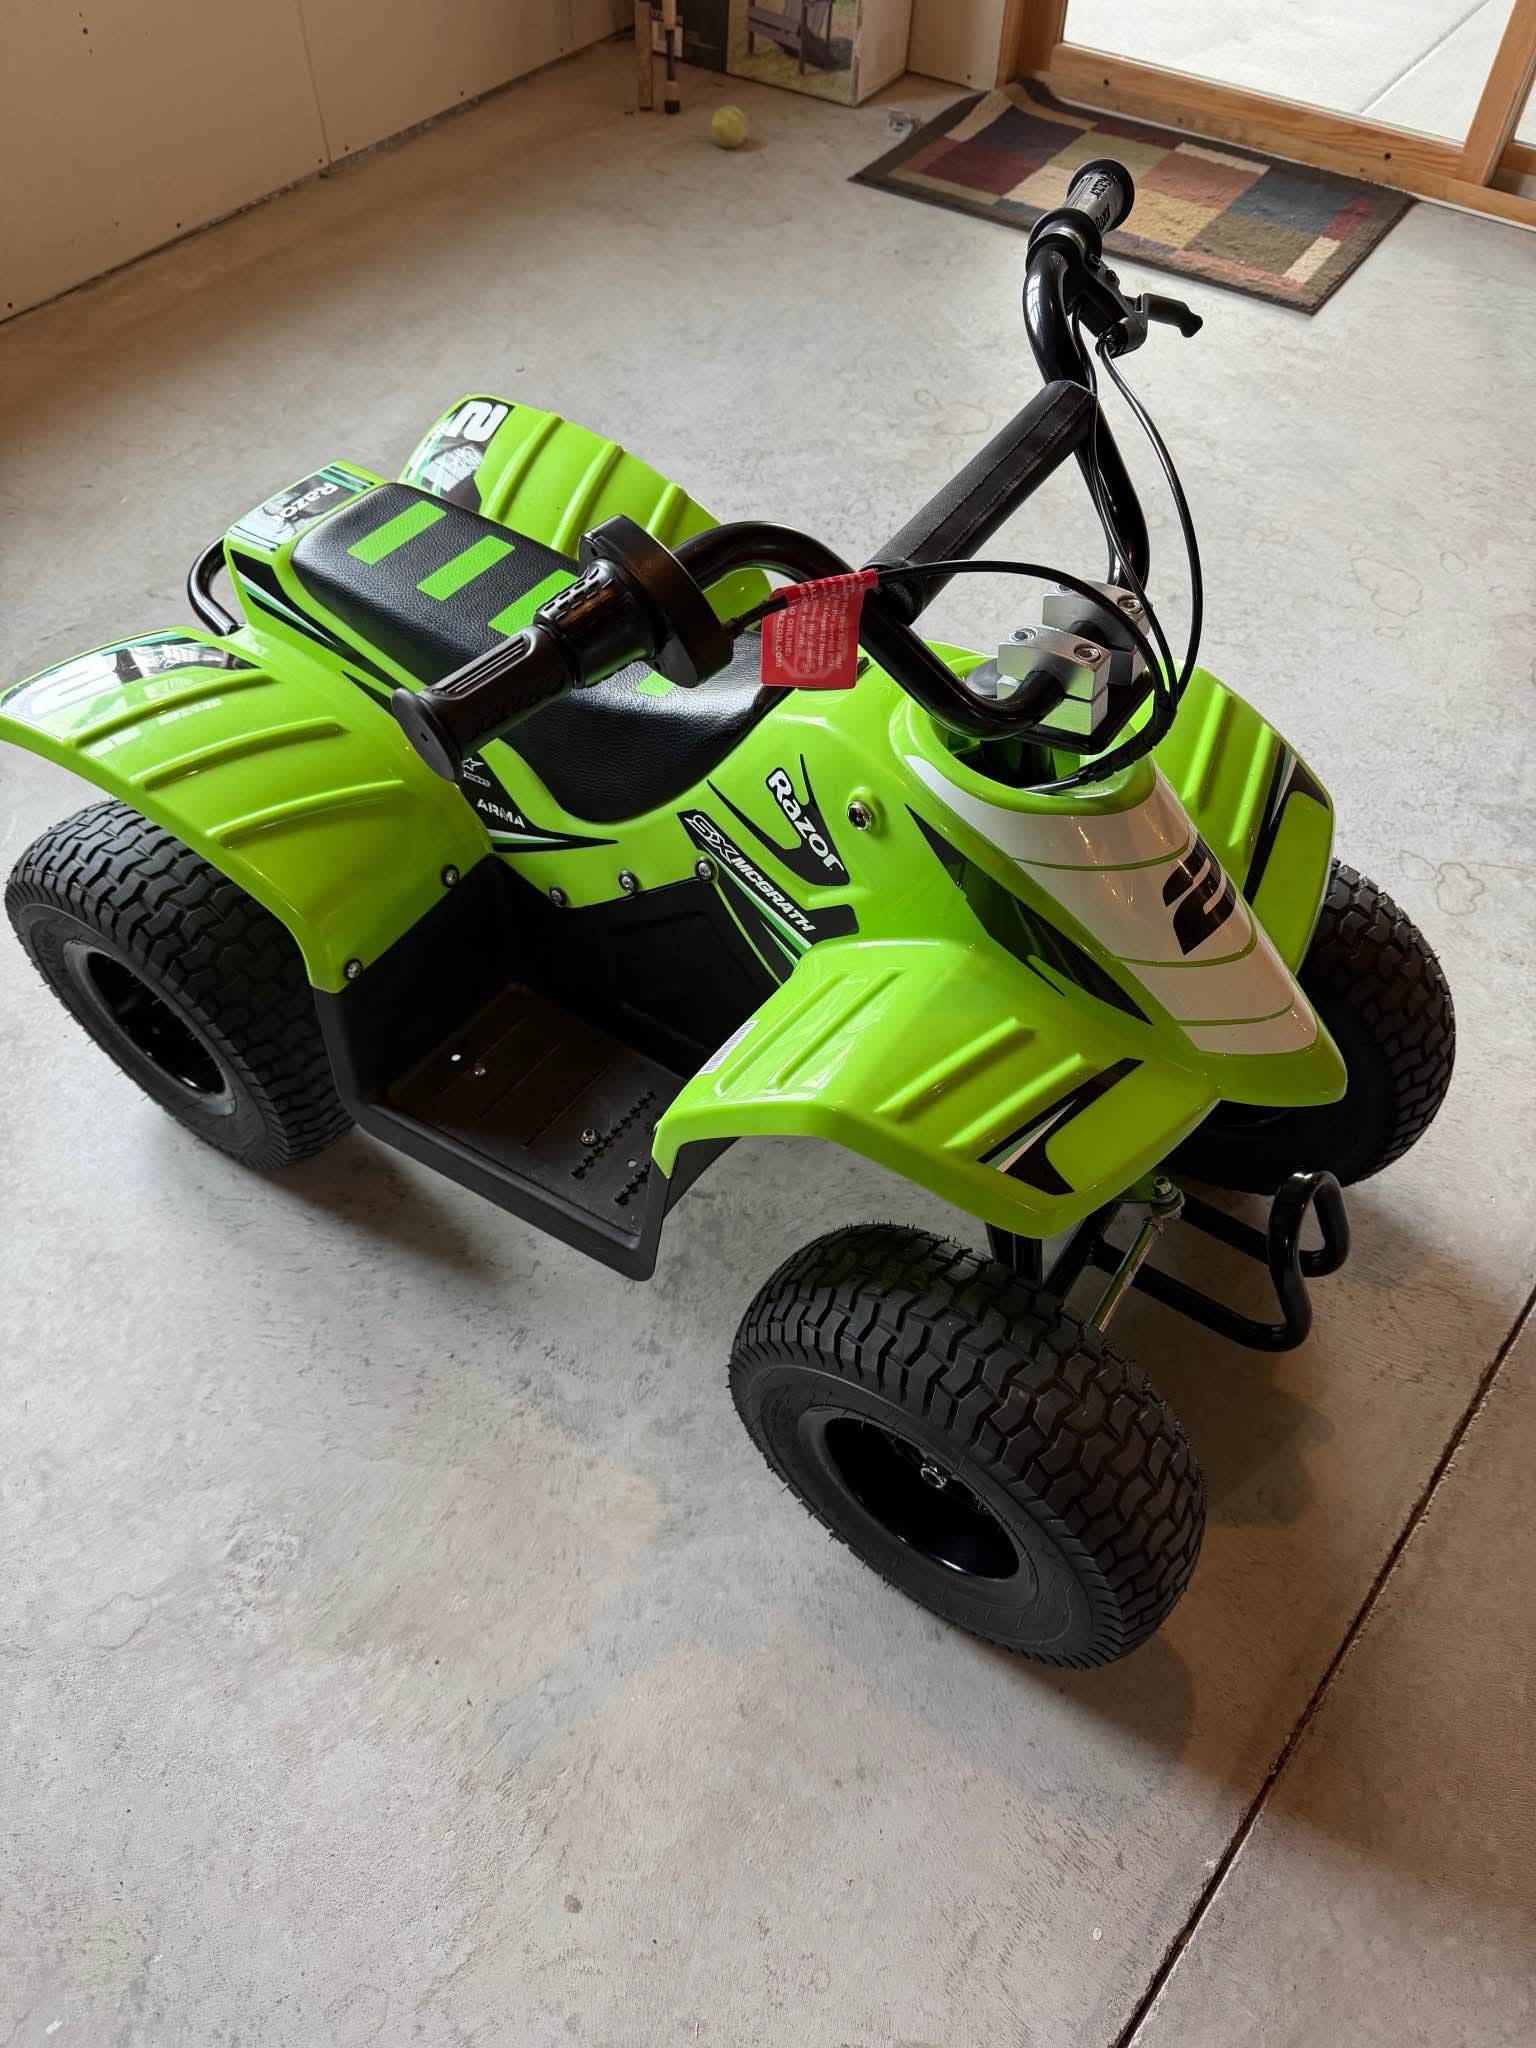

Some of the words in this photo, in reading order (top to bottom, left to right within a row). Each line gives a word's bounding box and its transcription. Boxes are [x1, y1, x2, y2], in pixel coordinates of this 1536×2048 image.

[785, 618, 795, 657] ONLINE:
[477, 799, 526, 829] ARMA
[768, 770, 845, 872] Razor
[684, 814, 740, 865] SX
[731, 856, 817, 933] MCGRATH
[1162, 832, 1237, 956] 2
